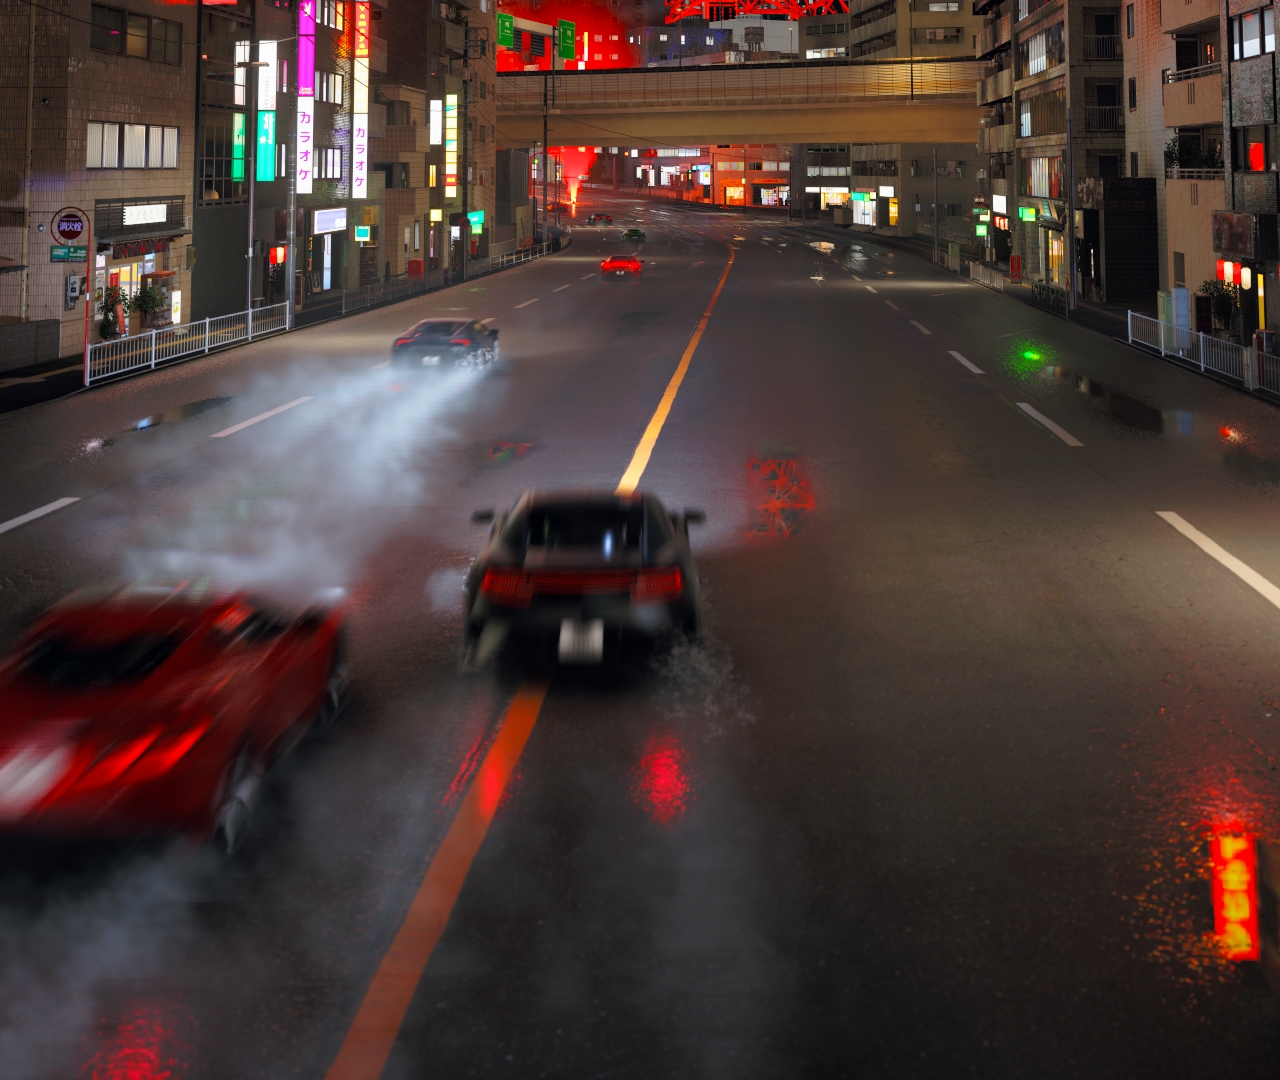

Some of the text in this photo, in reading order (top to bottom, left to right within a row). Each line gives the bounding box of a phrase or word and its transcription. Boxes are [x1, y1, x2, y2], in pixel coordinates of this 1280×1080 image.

[298, 112, 311, 181] カラオケ
[354, 127, 365, 187] カラオケ
[59, 221, 83, 231] 消火栓
